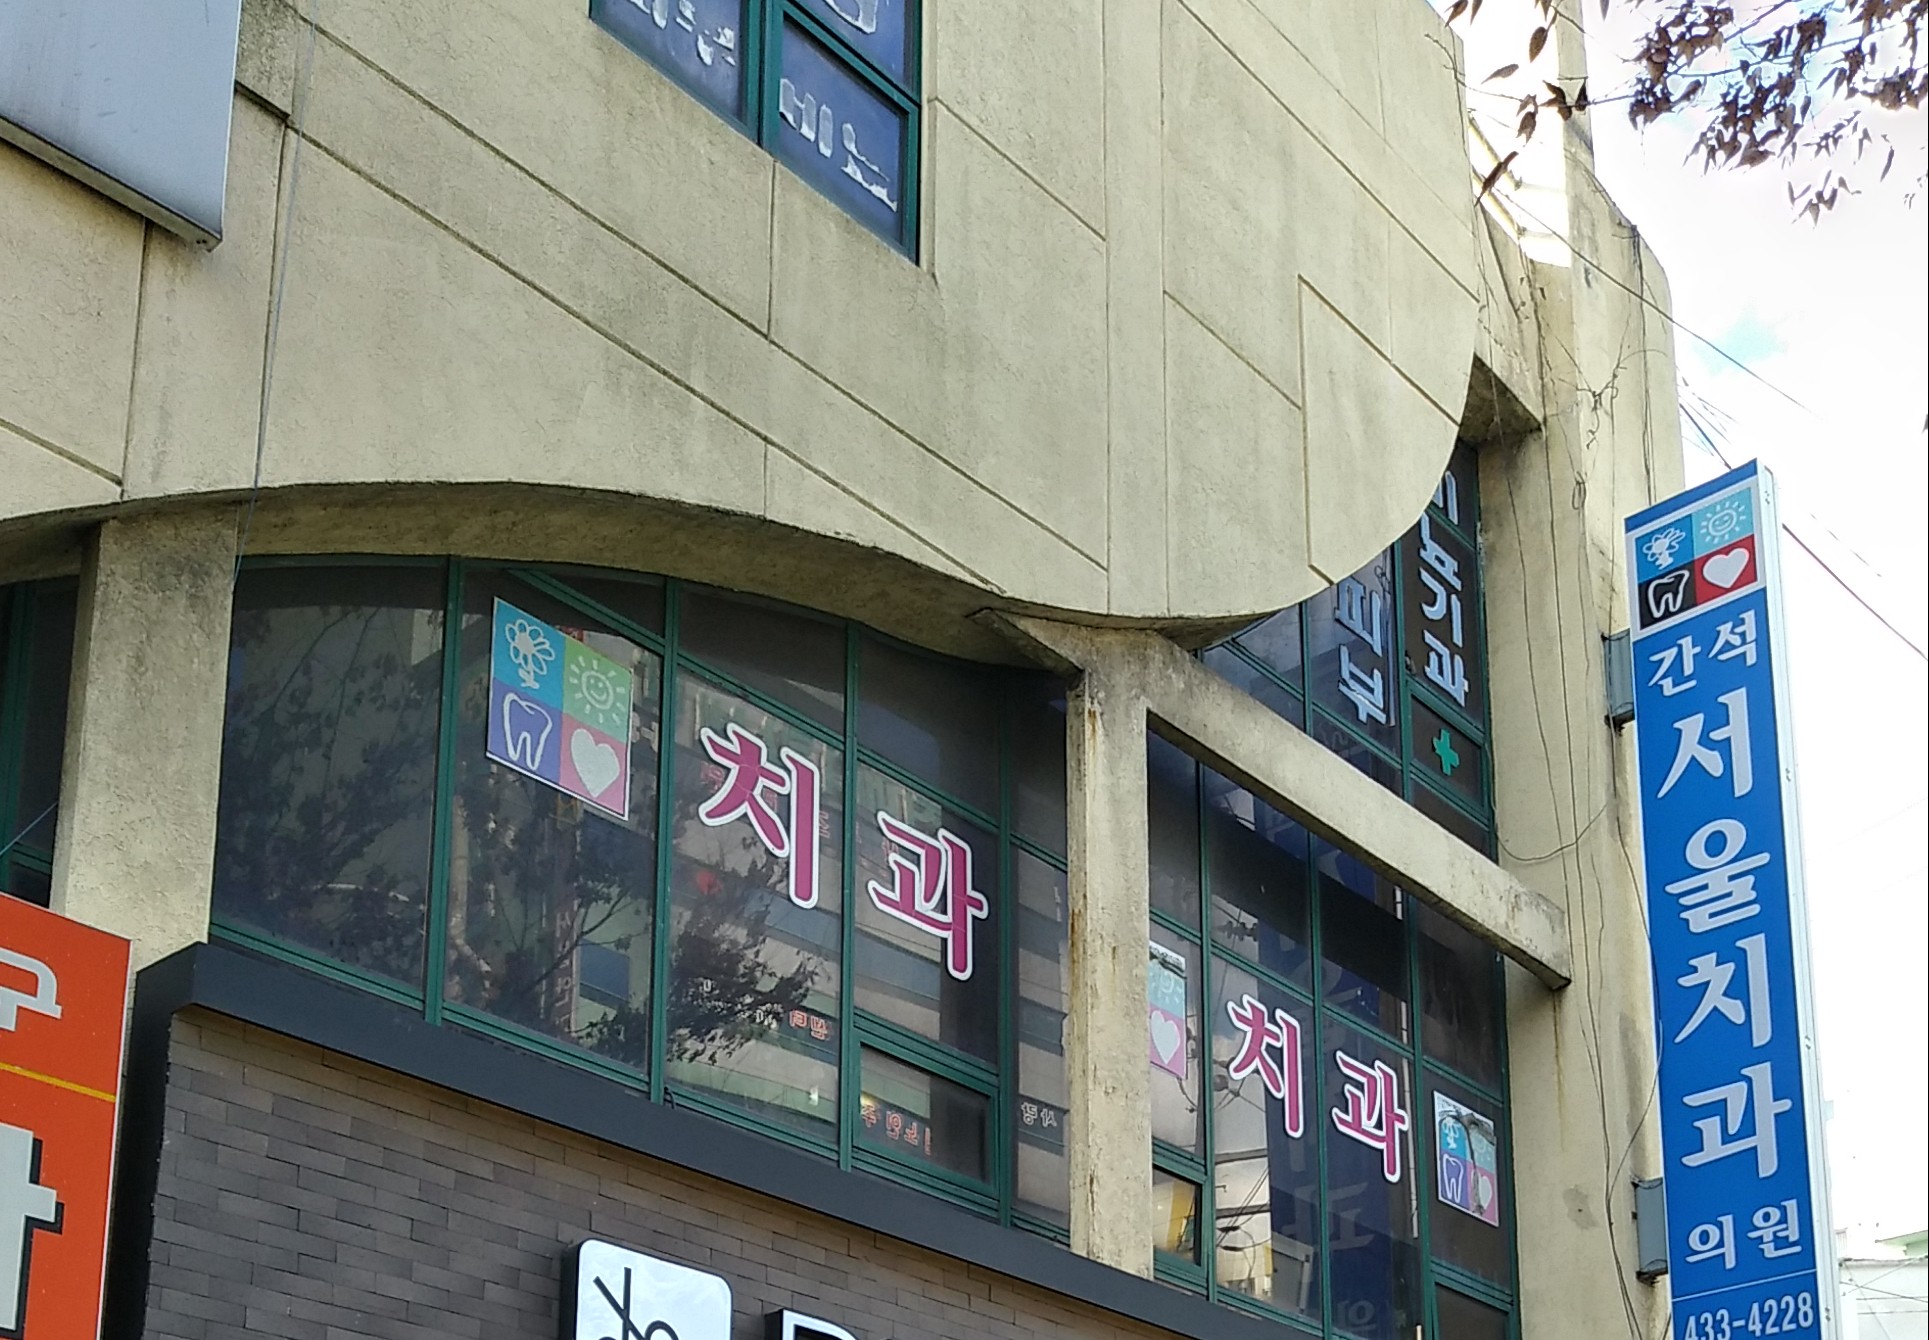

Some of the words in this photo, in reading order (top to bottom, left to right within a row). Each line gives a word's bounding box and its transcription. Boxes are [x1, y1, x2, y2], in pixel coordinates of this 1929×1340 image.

[1333, 575, 1388, 725] 피부
[1647, 609, 1758, 697] 간석
[699, 722, 989, 981] 치과
[1656, 686, 1793, 1179] 서울치과
[1226, 994, 1410, 1183] 치과
[1684, 1199, 1803, 1270] 의원
[1683, 1291, 1815, 1340] 433-4228
